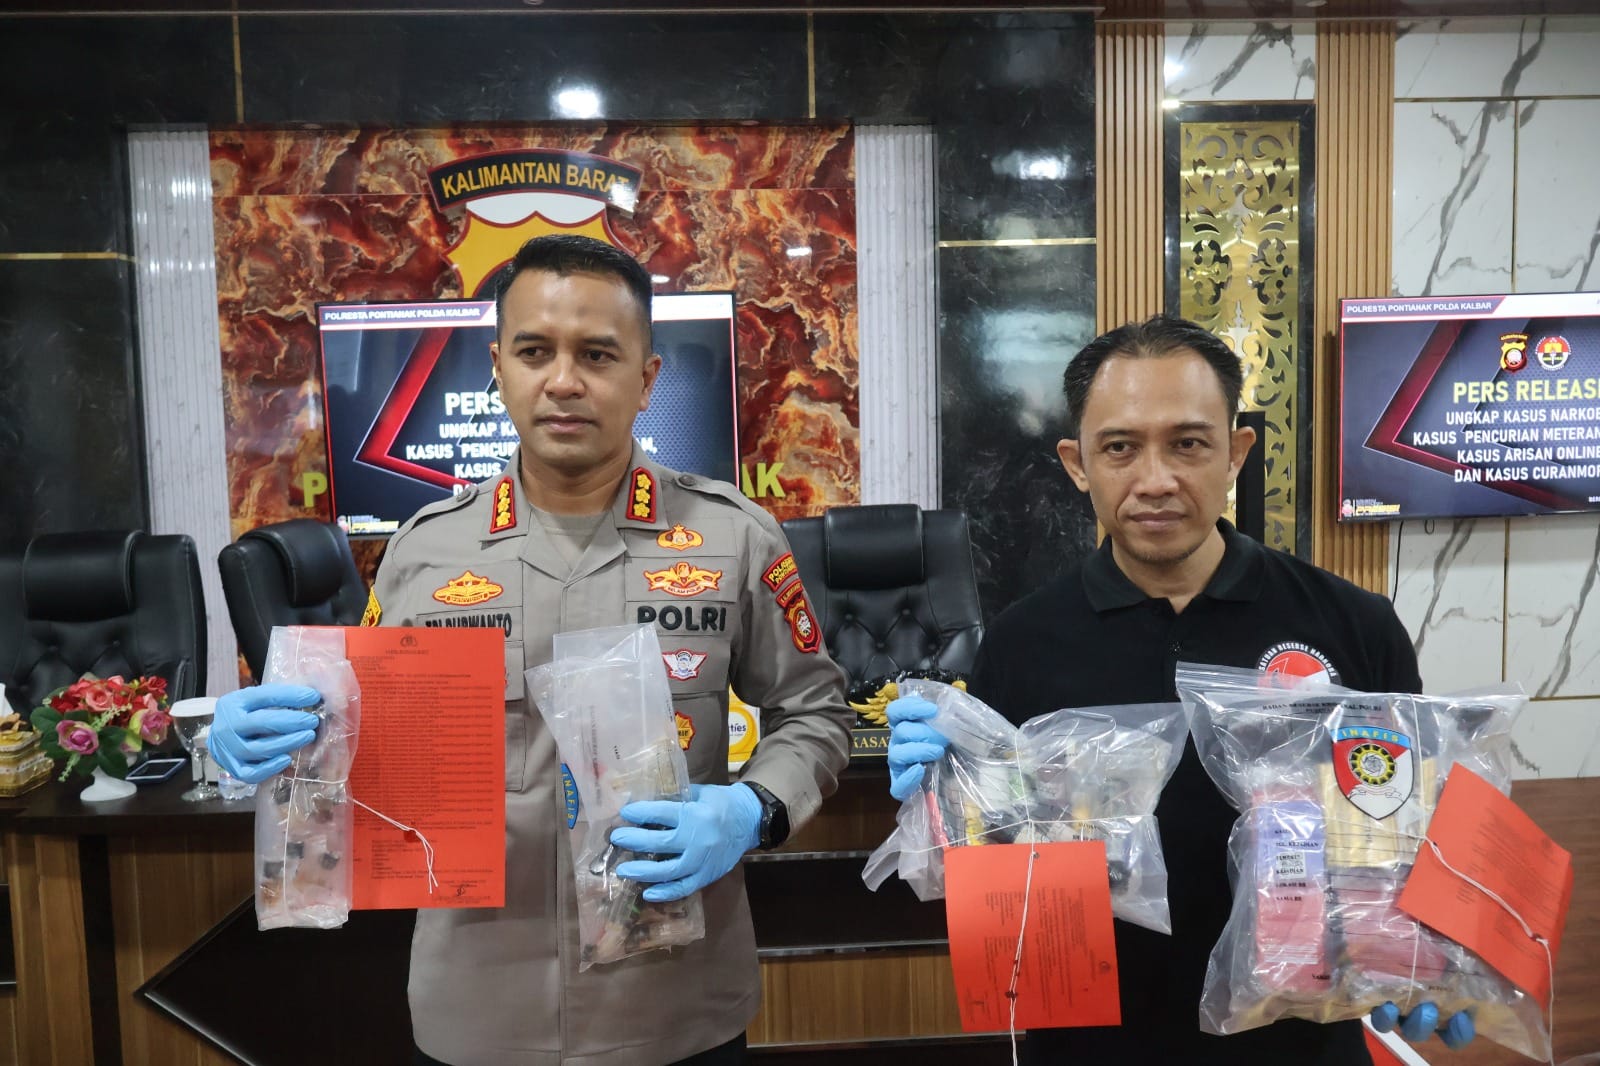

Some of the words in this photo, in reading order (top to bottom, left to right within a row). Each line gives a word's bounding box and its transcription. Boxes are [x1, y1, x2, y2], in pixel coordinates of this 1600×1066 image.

[441, 161, 560, 199] KALIMANTAN
[325, 308, 367, 321] POLRESTA
[1347, 304, 1387, 313] POLRESTA
[1388, 303, 1431, 312] PONTIANAK
[1433, 302, 1459, 311] POLDA
[1460, 301, 1492, 310] KALBAR
[1453, 380, 1509, 404] PERS
[1516, 377, 1600, 401] RELEAS
[444, 390, 506, 416] PERS
[1446, 409, 1500, 425] UNGKAP
[1503, 408, 1547, 423] KASUS
[439, 421, 498, 439] UNGKAP
[1413, 430, 1457, 446] KASUS
[1465, 427, 1539, 444] PENCURIAN
[406, 443, 454, 460] KASUS
[1457, 449, 1500, 463] KASUS
[1504, 447, 1553, 461] ARISAN
[454, 462, 503, 479] KASUS
[1454, 468, 1481, 482] DAN
[1485, 466, 1528, 481] KASUS
[637, 605, 727, 631] POLRI
[853, 736, 892, 749] KASA
[1342, 728, 1400, 743] INAFIS
[562, 773, 575, 820] INAFIS
